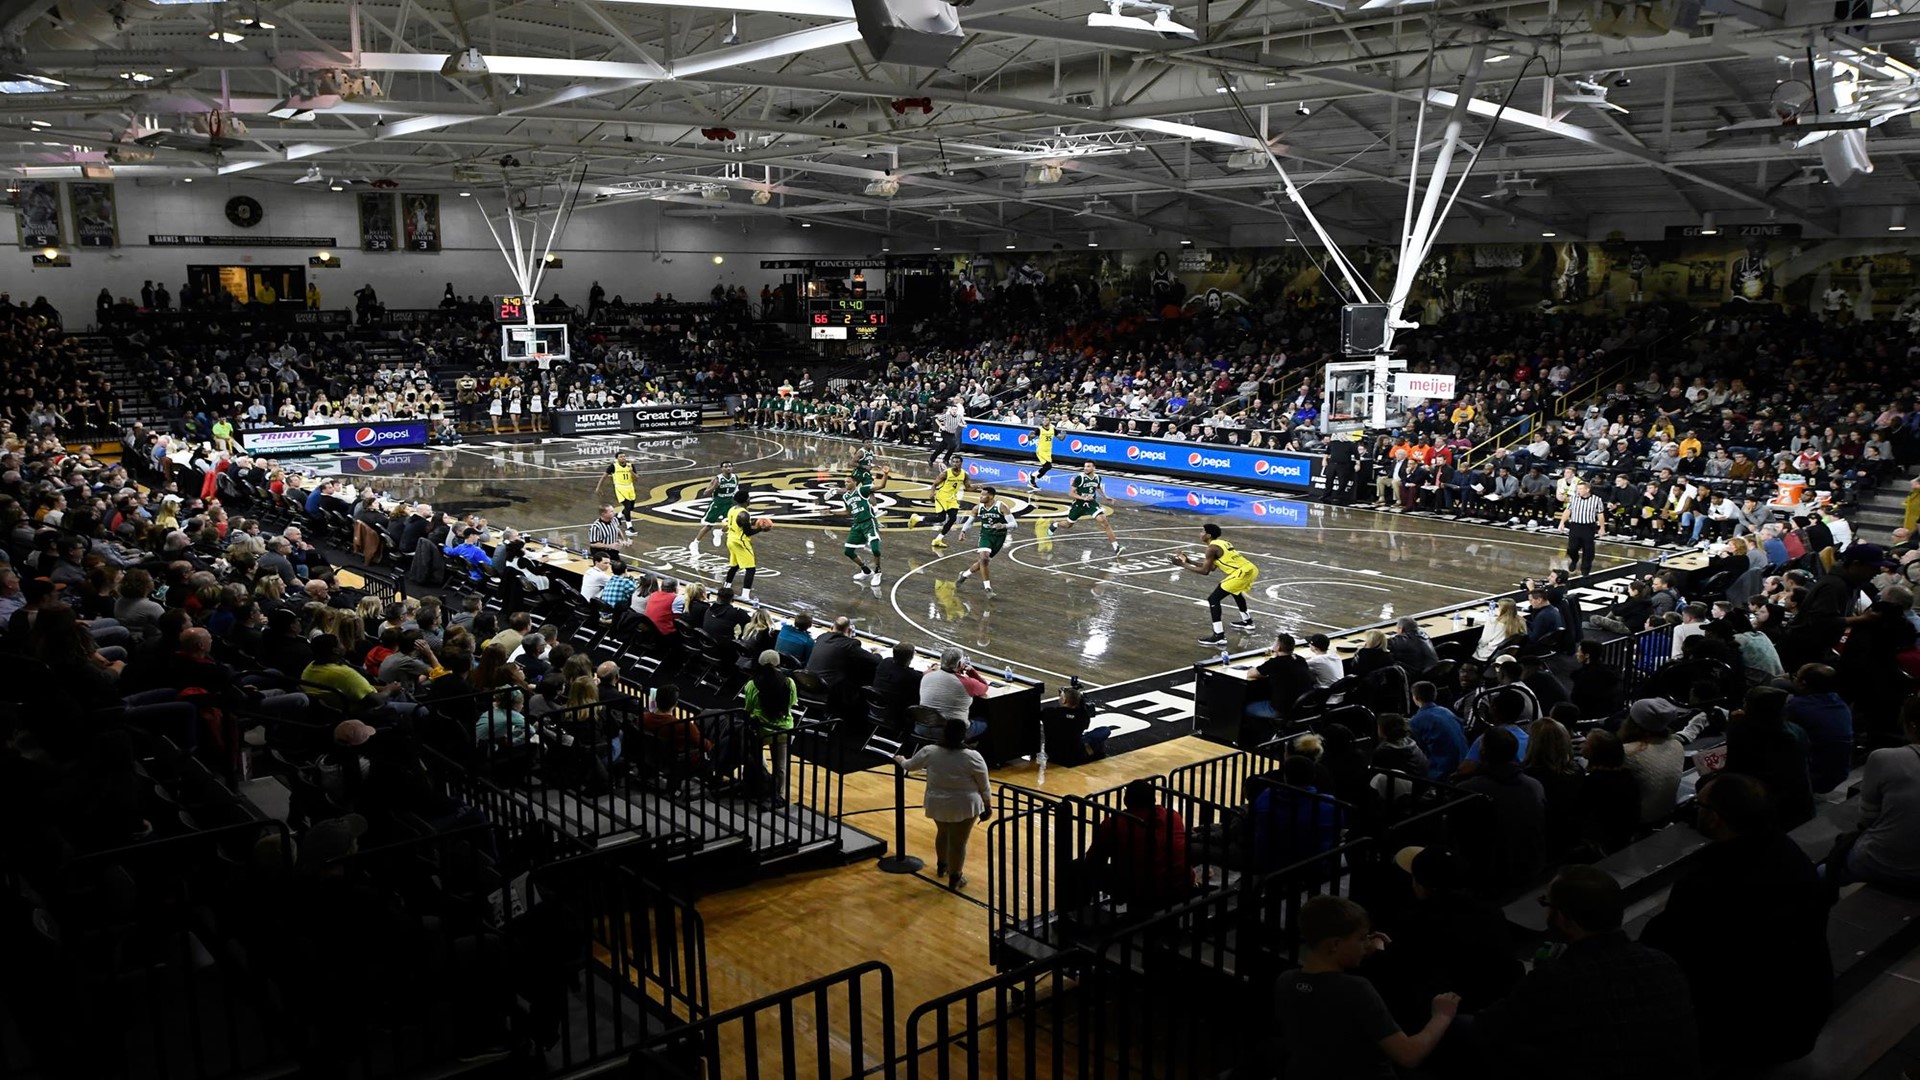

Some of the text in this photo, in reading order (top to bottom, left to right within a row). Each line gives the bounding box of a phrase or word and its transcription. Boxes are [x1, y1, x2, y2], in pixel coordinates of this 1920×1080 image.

[1741, 226, 1782, 236] ZONE
[37, 236, 48, 245] 5
[94, 236, 101, 245] 1
[371, 240, 388, 248] 34
[419, 241, 428, 249] 3
[503, 297, 521, 305] 9:40
[839, 300, 863, 309] 9:40
[501, 305, 519, 318] 24
[814, 314, 828, 323] 66
[844, 314, 851, 323] 2
[870, 314, 884, 323] 51
[1410, 378, 1454, 395] meijer
[577, 412, 619, 422] HITACHI
[635, 409, 698, 421] Great Clips
[260, 431, 315, 441] TRINITY
[378, 429, 410, 441] pepsi
[979, 432, 1001, 442] pepsi
[1082, 444, 1107, 454] pepsi
[1140, 450, 1167, 461] pepsi
[1202, 457, 1231, 469] pepsi
[1270, 464, 1301, 477] pepsi
